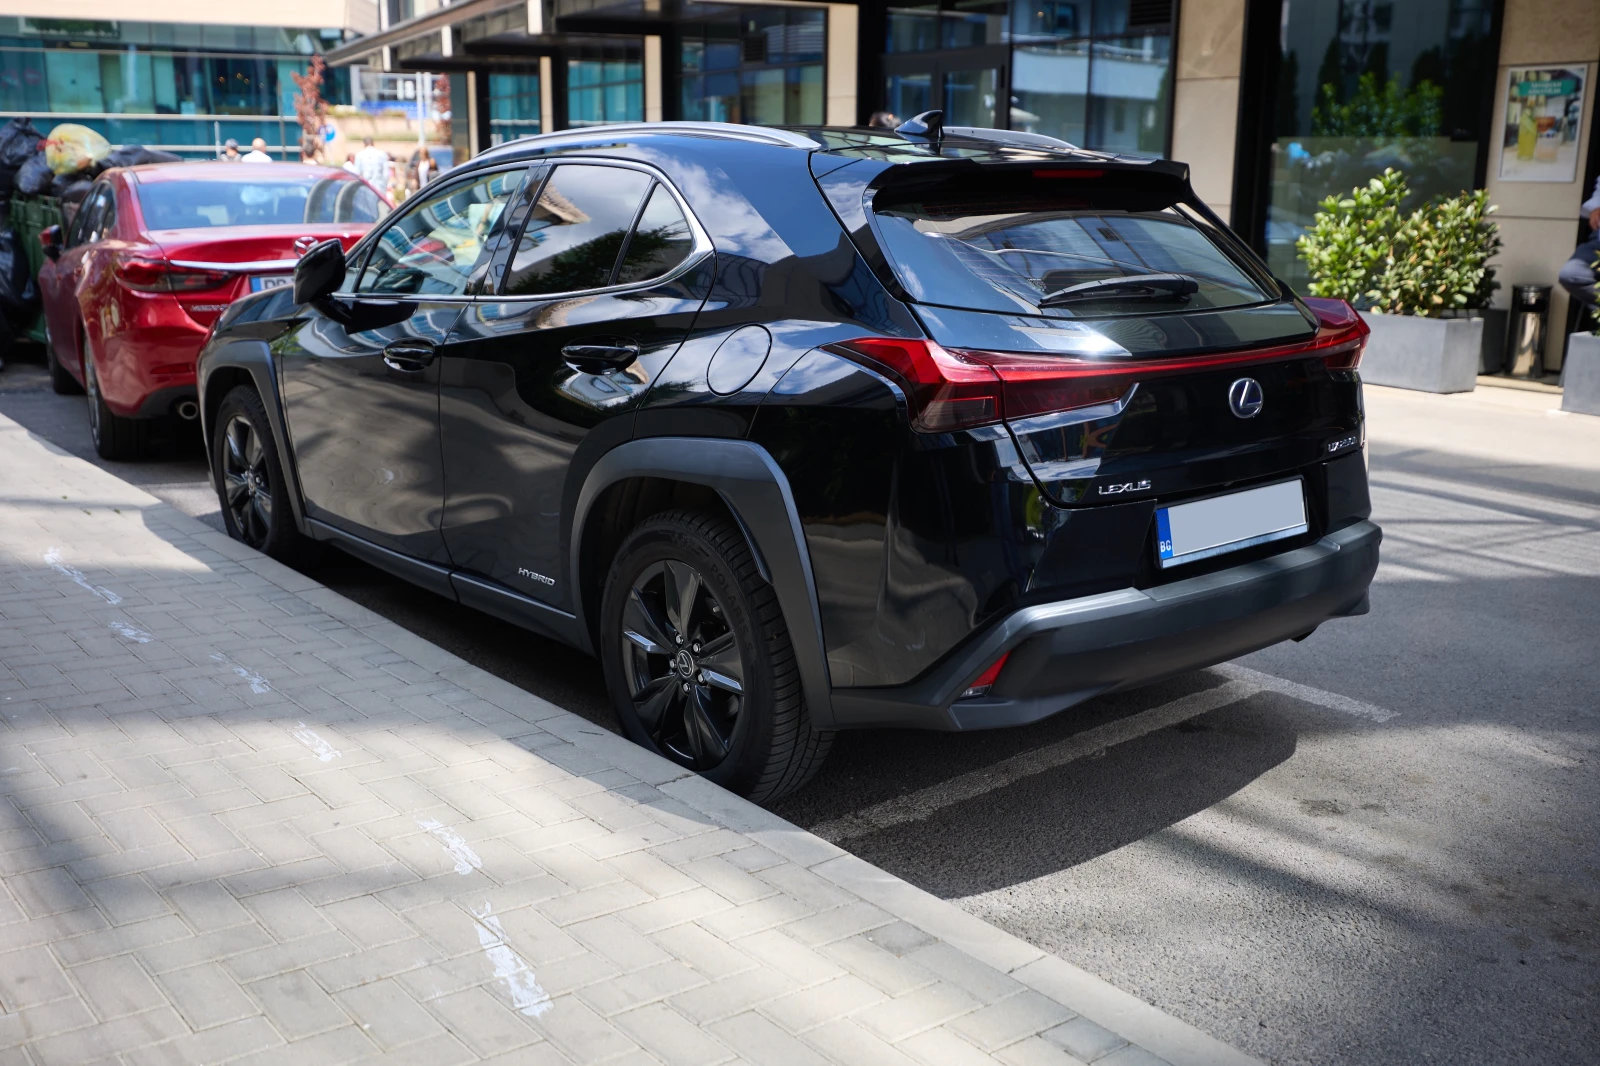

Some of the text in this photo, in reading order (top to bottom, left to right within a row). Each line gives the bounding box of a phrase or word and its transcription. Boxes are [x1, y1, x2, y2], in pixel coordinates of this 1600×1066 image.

[1098, 480, 1151, 495] LEXUS
[1160, 539, 1172, 553] BG
[518, 567, 555, 586] HYBRID
[711, 563, 750, 635] POLARIS
